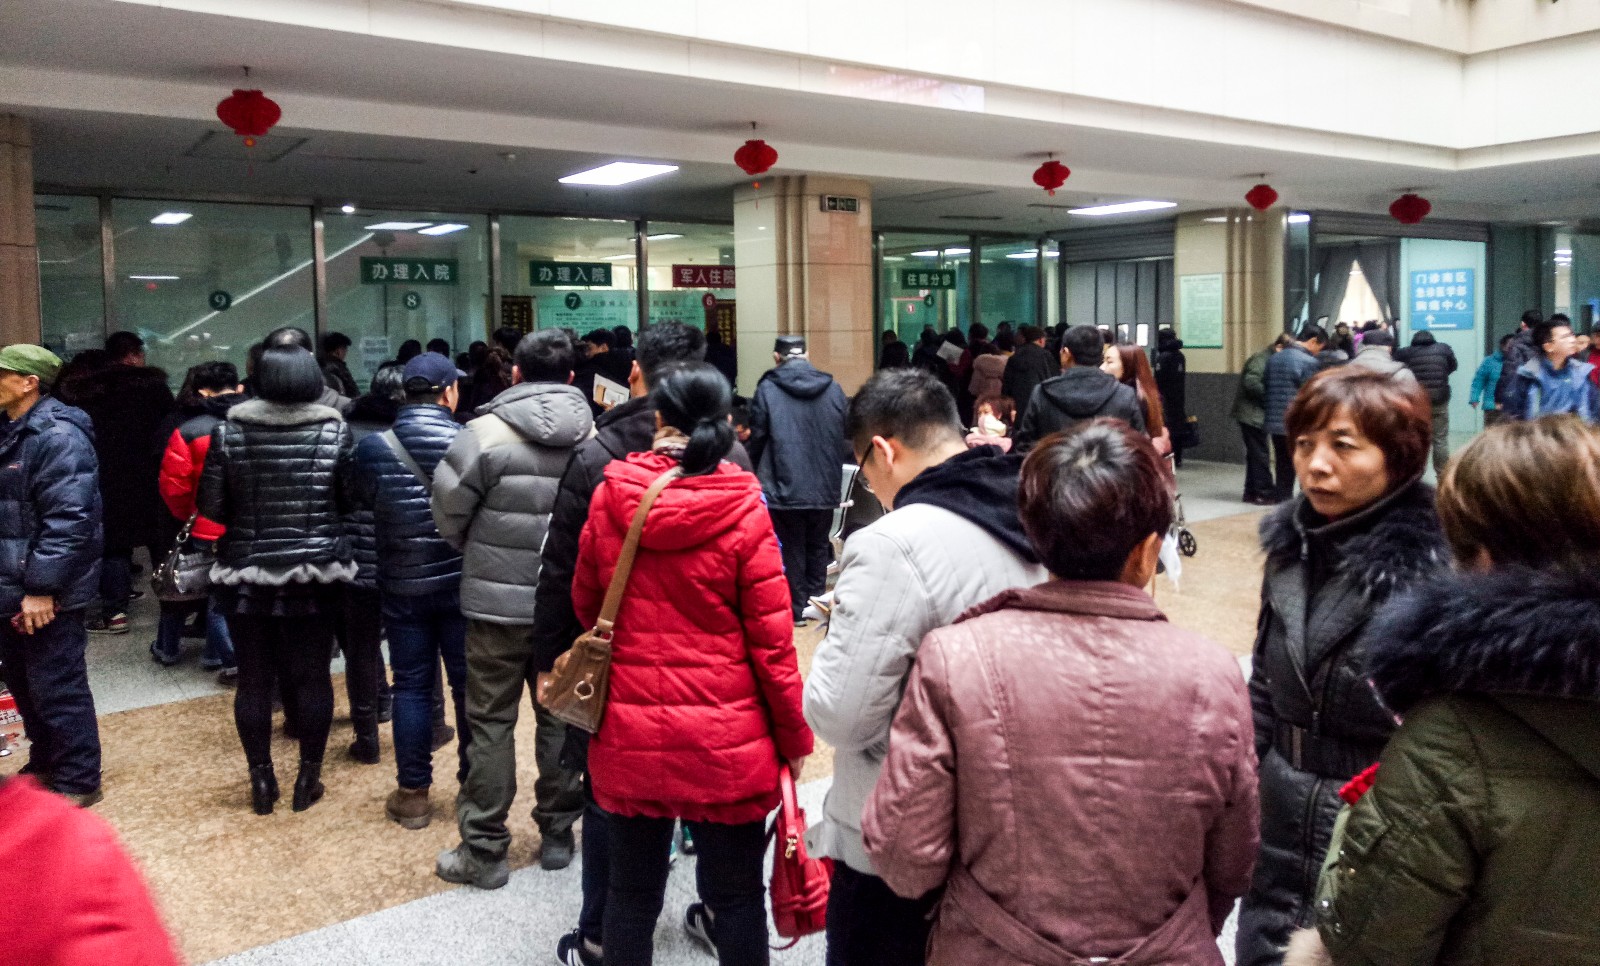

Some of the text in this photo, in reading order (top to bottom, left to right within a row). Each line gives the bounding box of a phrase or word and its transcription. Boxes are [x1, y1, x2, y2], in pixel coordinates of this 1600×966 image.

[371, 262, 450, 280] 办理入院
[538, 266, 606, 283] 办理入院
[680, 268, 735, 284] 军人住院
[214, 294, 226, 308] 9
[406, 293, 417, 307] 8
[568, 296, 578, 308] 7
